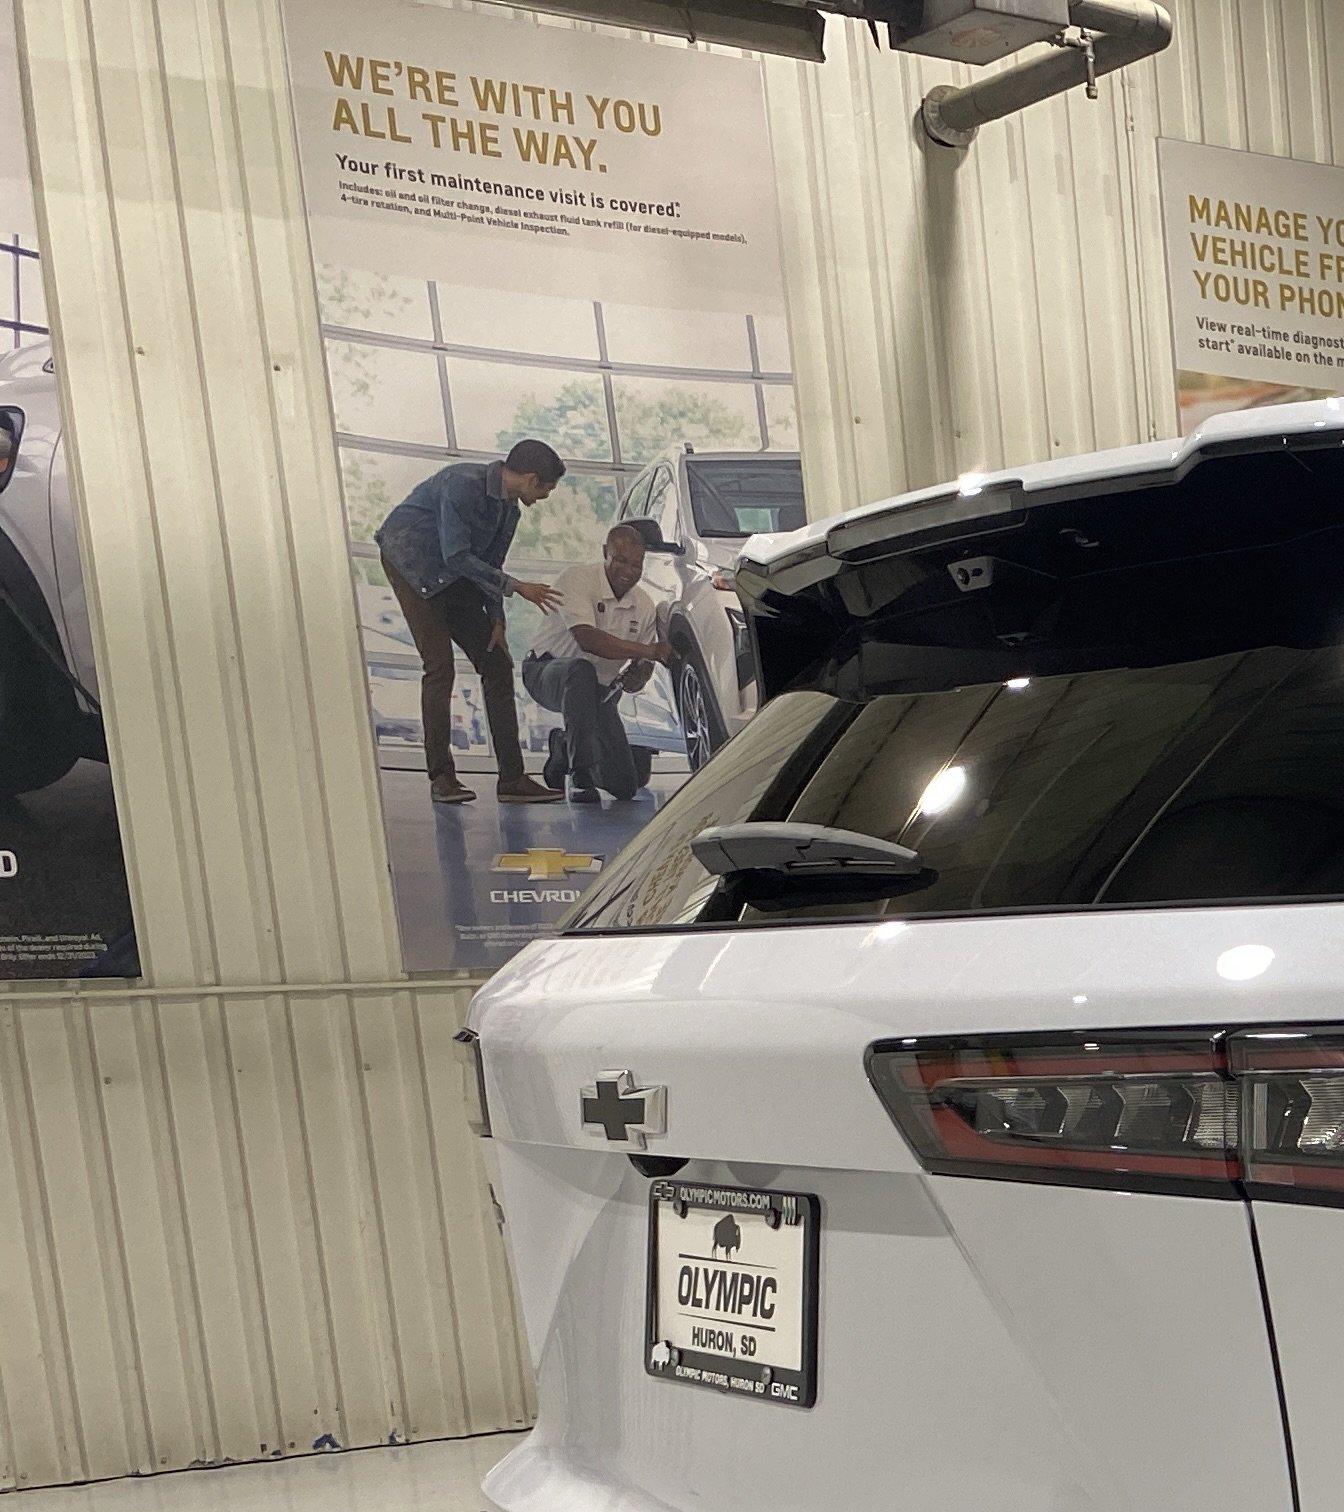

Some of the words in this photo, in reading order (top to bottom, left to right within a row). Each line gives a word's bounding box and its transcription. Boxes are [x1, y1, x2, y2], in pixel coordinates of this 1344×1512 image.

[324, 50, 459, 107] WE'RE
[469, 76, 575, 125] WITH
[585, 94, 662, 137] YOU
[332, 98, 412, 144] ALL
[422, 113, 503, 158] THE
[513, 127, 608, 173] WAY.
[335, 153, 379, 175] Your
[384, 162, 425, 184] first
[431, 172, 545, 201] maintenance
[549, 188, 586, 207] visit
[591, 192, 605, 209] is
[338, 180, 383, 197] Includes:
[385, 189, 396, 199] oil
[398, 191, 416, 202] and
[418, 194, 430, 203] oil
[432, 195, 454, 208] filter
[456, 199, 493, 214] change,
[495, 205, 522, 217] diesel
[523, 209, 558, 223] exhaust
[560, 214, 580, 225] fluid
[582, 217, 601, 227] tank
[603, 220, 624, 230] refill
[340, 193, 369, 206] 4-tire
[371, 199, 413, 215] rotation,
[414, 206, 432, 217] and
[433, 210, 485, 225] Multi-Point
[486, 217, 519, 230] Vehicle
[520, 221, 570, 236] Inspection.
[1188, 195, 1309, 242] MANAGE
[1190, 232, 1310, 279] VEHICLE
[1193, 270, 1270, 309] YOUR
[1196, 316, 1227, 333] View
[1231, 323, 1290, 342] real-time
[1237, 343, 1292, 360] available
[1296, 351, 1310, 363] on
[1314, 352, 1333, 366] the
[680, 1186, 770, 1210] OLYMPICMOTORS.COM
[678, 1265, 777, 1320] OLYMPIC
[692, 1326, 737, 1358] HURON,
[741, 1335, 757, 1357] SD
[675, 1365, 701, 1380] OLYMPIC
[730, 1376, 754, 1392] HURON
[771, 1382, 798, 1401] GMC
